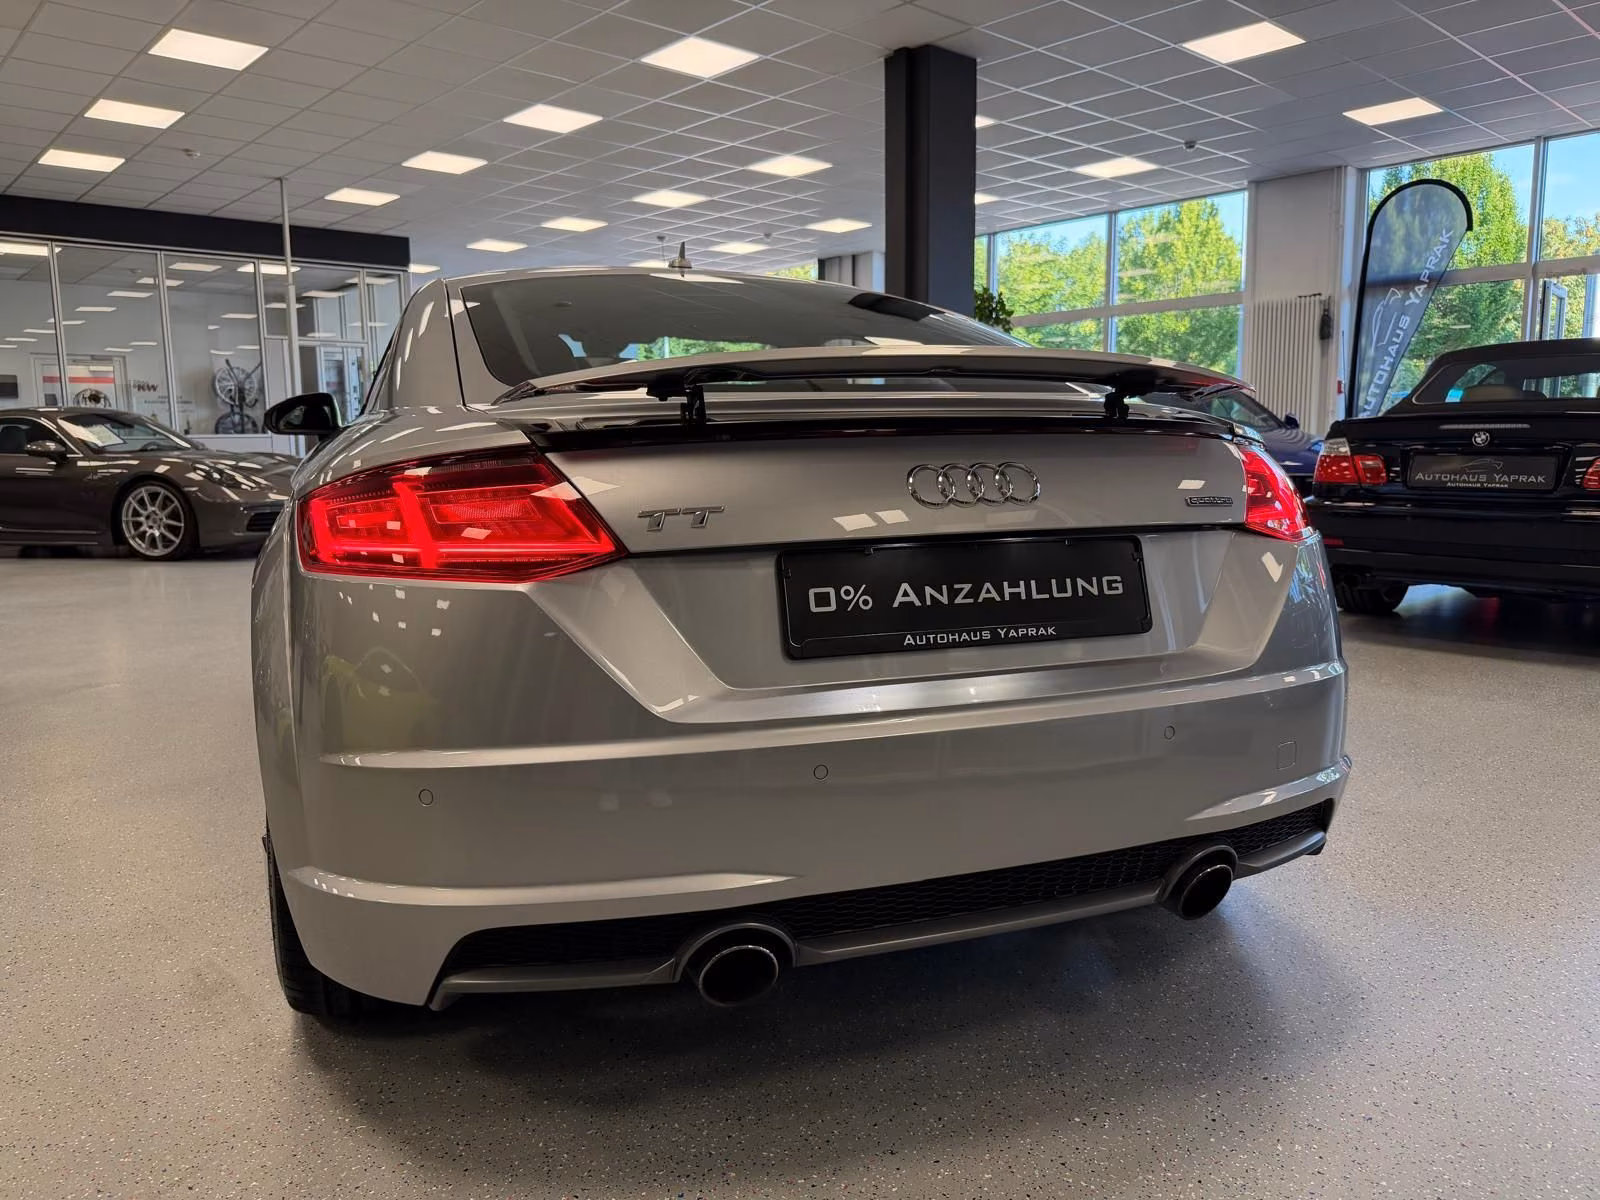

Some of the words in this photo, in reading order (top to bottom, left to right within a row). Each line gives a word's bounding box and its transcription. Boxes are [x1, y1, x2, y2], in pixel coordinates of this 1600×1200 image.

[1404, 228, 1454, 307] YAPRAK
[1415, 472, 1487, 483] AUTOHAUS
[1493, 473, 1546, 484] YAPRAK
[637, 506, 725, 532] TT
[808, 584, 873, 613] 0%
[892, 575, 1124, 608] ANZAHLUNG
[903, 629, 991, 646] AUTOHAUS
[997, 625, 1057, 640] YAPRAK
